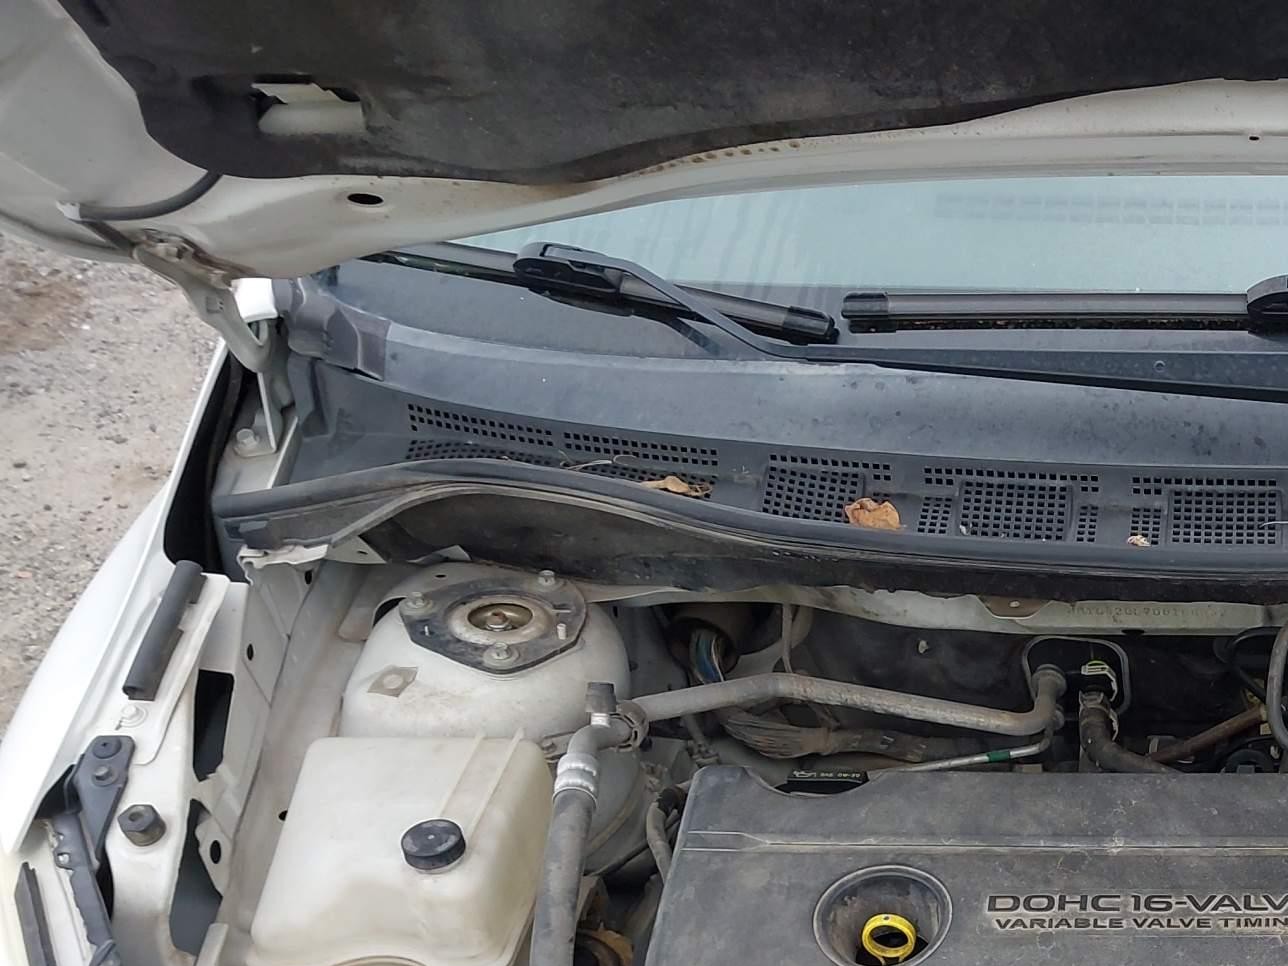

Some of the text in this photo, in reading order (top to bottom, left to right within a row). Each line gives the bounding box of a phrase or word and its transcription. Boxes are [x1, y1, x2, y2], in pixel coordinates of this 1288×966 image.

[987, 893, 1121, 913] DOHC
[995, 917, 1124, 929] VARIABLE
[1131, 917, 1212, 929] VALVE
